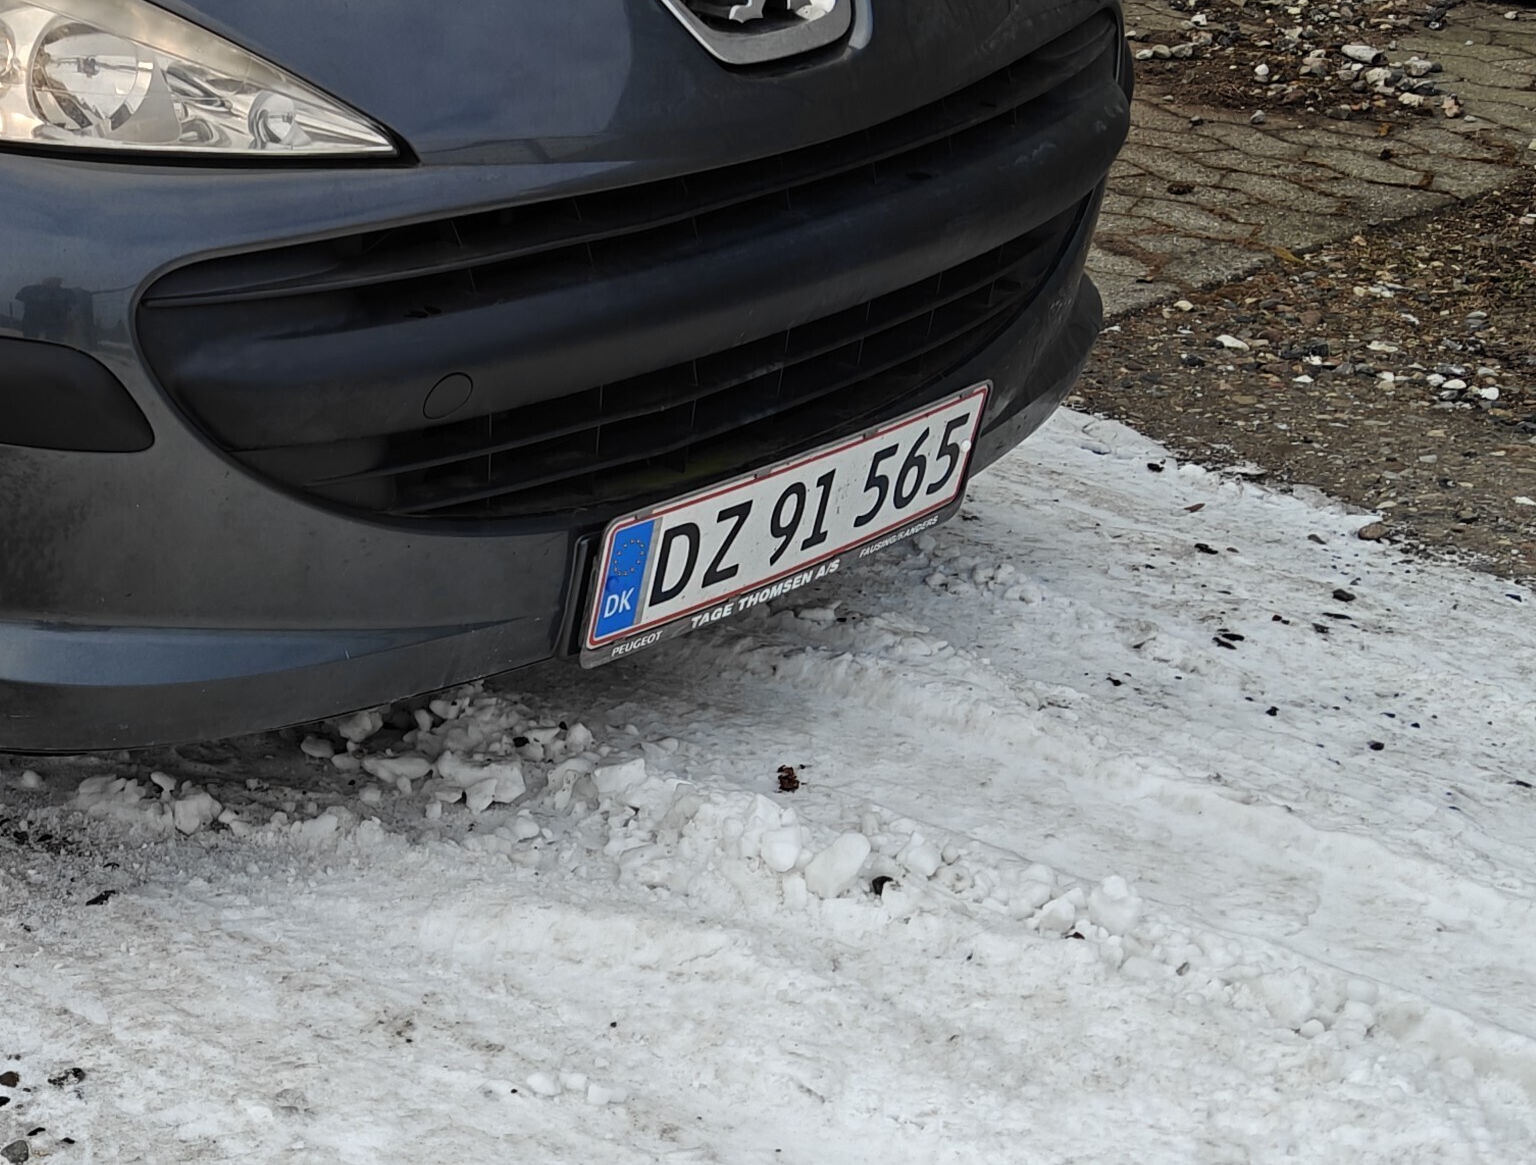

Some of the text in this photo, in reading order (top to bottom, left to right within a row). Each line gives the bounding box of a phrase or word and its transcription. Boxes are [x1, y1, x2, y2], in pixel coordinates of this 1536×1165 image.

[648, 412, 971, 608] DZ 91 565
[603, 586, 636, 619] DK
[690, 558, 841, 630] TAGE THOMSEN A/S
[611, 630, 664, 658] PEUGEOT
